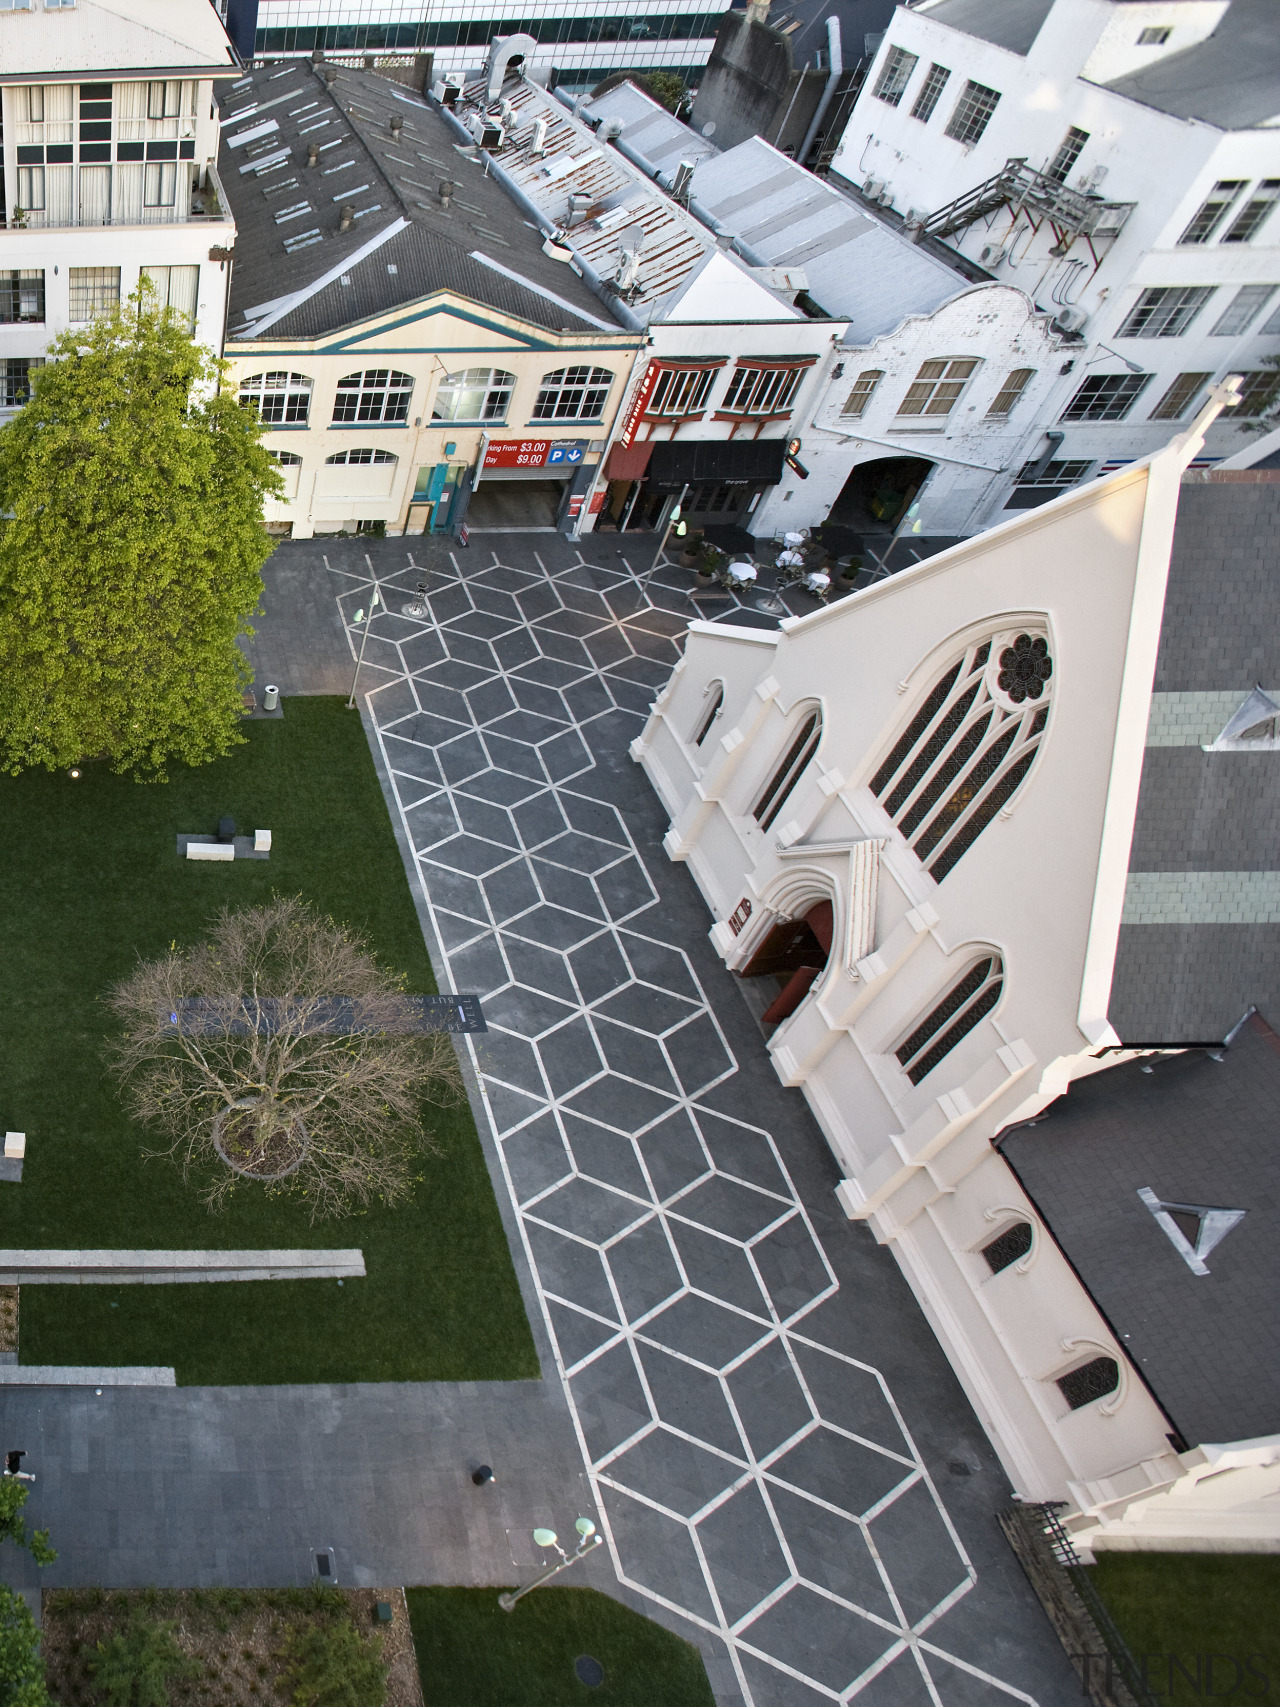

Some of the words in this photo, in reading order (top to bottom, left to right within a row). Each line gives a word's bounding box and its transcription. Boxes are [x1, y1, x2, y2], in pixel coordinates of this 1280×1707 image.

[487, 444, 502, 453] rking
[502, 444, 518, 452] From
[520, 442, 546, 453] $3.00
[486, 456, 498, 465] Day
[516, 454, 542, 465] $9.00
[551, 450, 563, 461] P
[463, 998, 478, 1028] WELL
